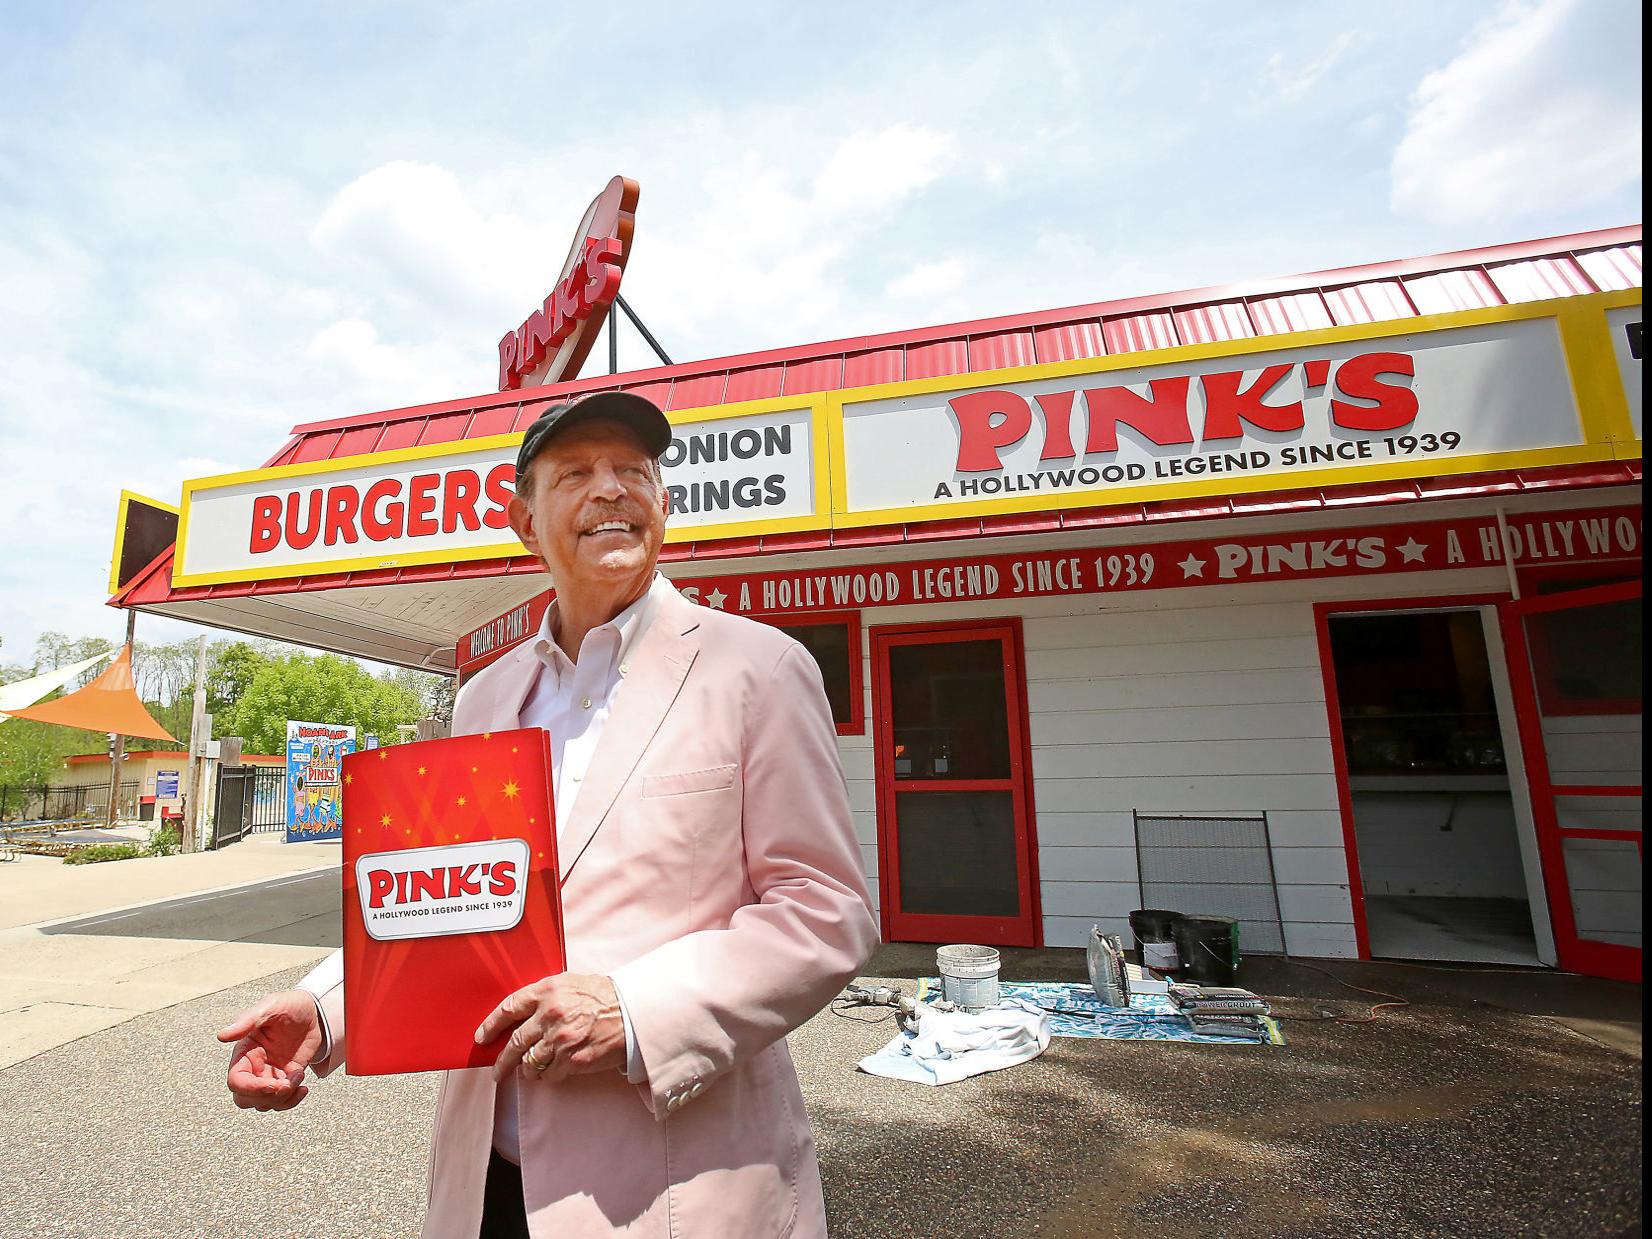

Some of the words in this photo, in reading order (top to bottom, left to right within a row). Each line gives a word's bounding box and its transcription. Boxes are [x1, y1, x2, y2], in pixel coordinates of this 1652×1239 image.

[948, 352, 1419, 472] PINK'S
[659, 425, 791, 468] ONION
[934, 482, 952, 499] A
[960, 463, 1146, 497] HOLLYWOOD
[1155, 450, 1271, 478] LEGEND
[1281, 439, 1372, 466] SINCE
[1383, 431, 1461, 456] 1939
[249, 463, 518, 554] BURGERS
[667, 474, 786, 515] RINGS
[739, 582, 751, 610] A
[763, 571, 900, 609] HOLLYWOOD
[912, 564, 999, 599] LEGEND
[1012, 558, 1083, 593] SINCE
[1094, 552, 1155, 587] 1939
[1214, 537, 1387, 578] PINK'S
[1447, 529, 1465, 564] A
[1478, 516, 1642, 561] HOLLYWO
[470, 622, 495, 659] WELCOME
[496, 617, 505, 646] TO
[367, 861, 516, 908] PINK'S
[379, 909, 430, 919] HOLLYWOOD
[432, 905, 463, 915] LEGEND
[465, 902, 490, 912] SINCE
[492, 900, 513, 909] 1939
